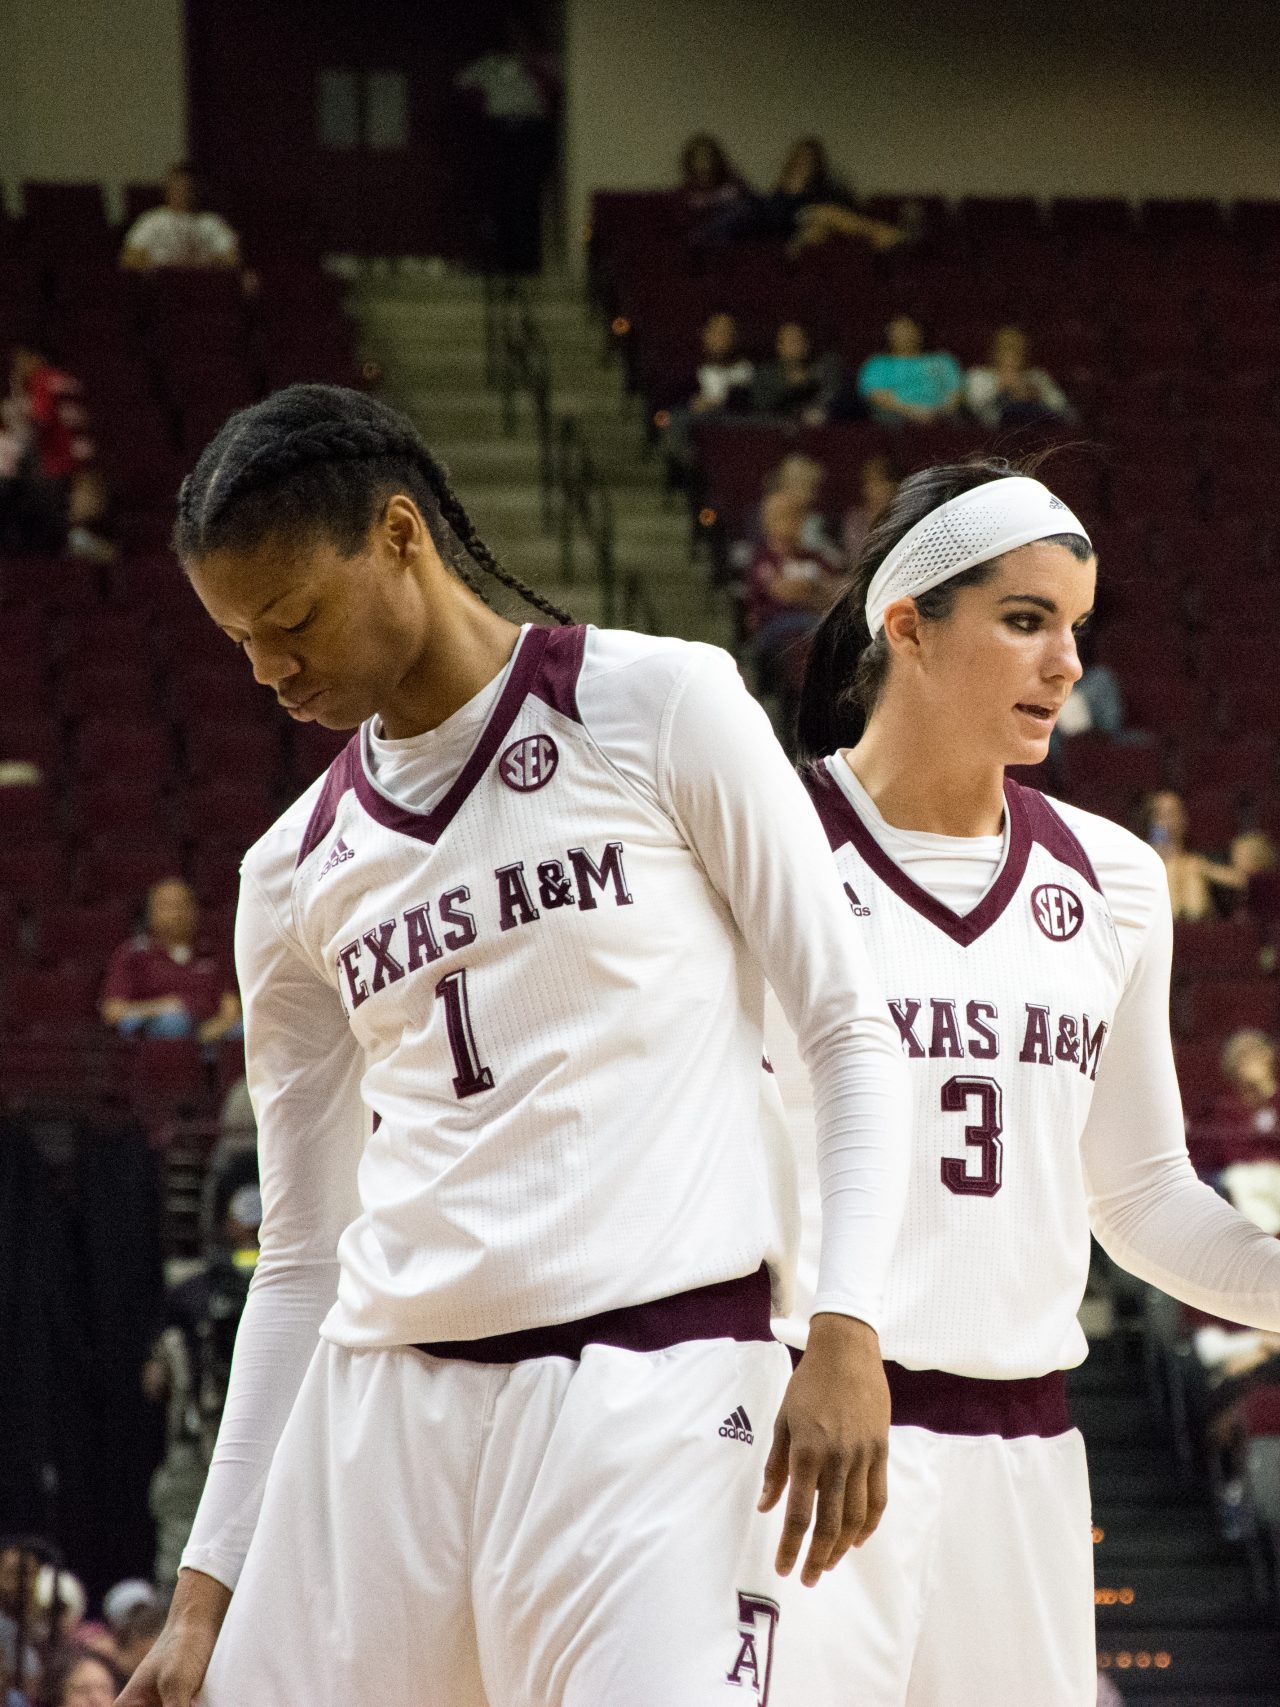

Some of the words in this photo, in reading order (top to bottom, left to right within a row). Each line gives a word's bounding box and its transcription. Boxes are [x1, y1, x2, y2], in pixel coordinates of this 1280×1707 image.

[506, 737, 553, 787] SEC
[337, 885, 478, 1015] EXAS
[495, 842, 634, 931] A&M
[1038, 887, 1079, 937] SEC
[435, 968, 495, 1099] 1
[1019, 1003, 1108, 1081] A&M
[941, 1075, 1003, 1198] 3
[718, 1426, 754, 1446] adida
